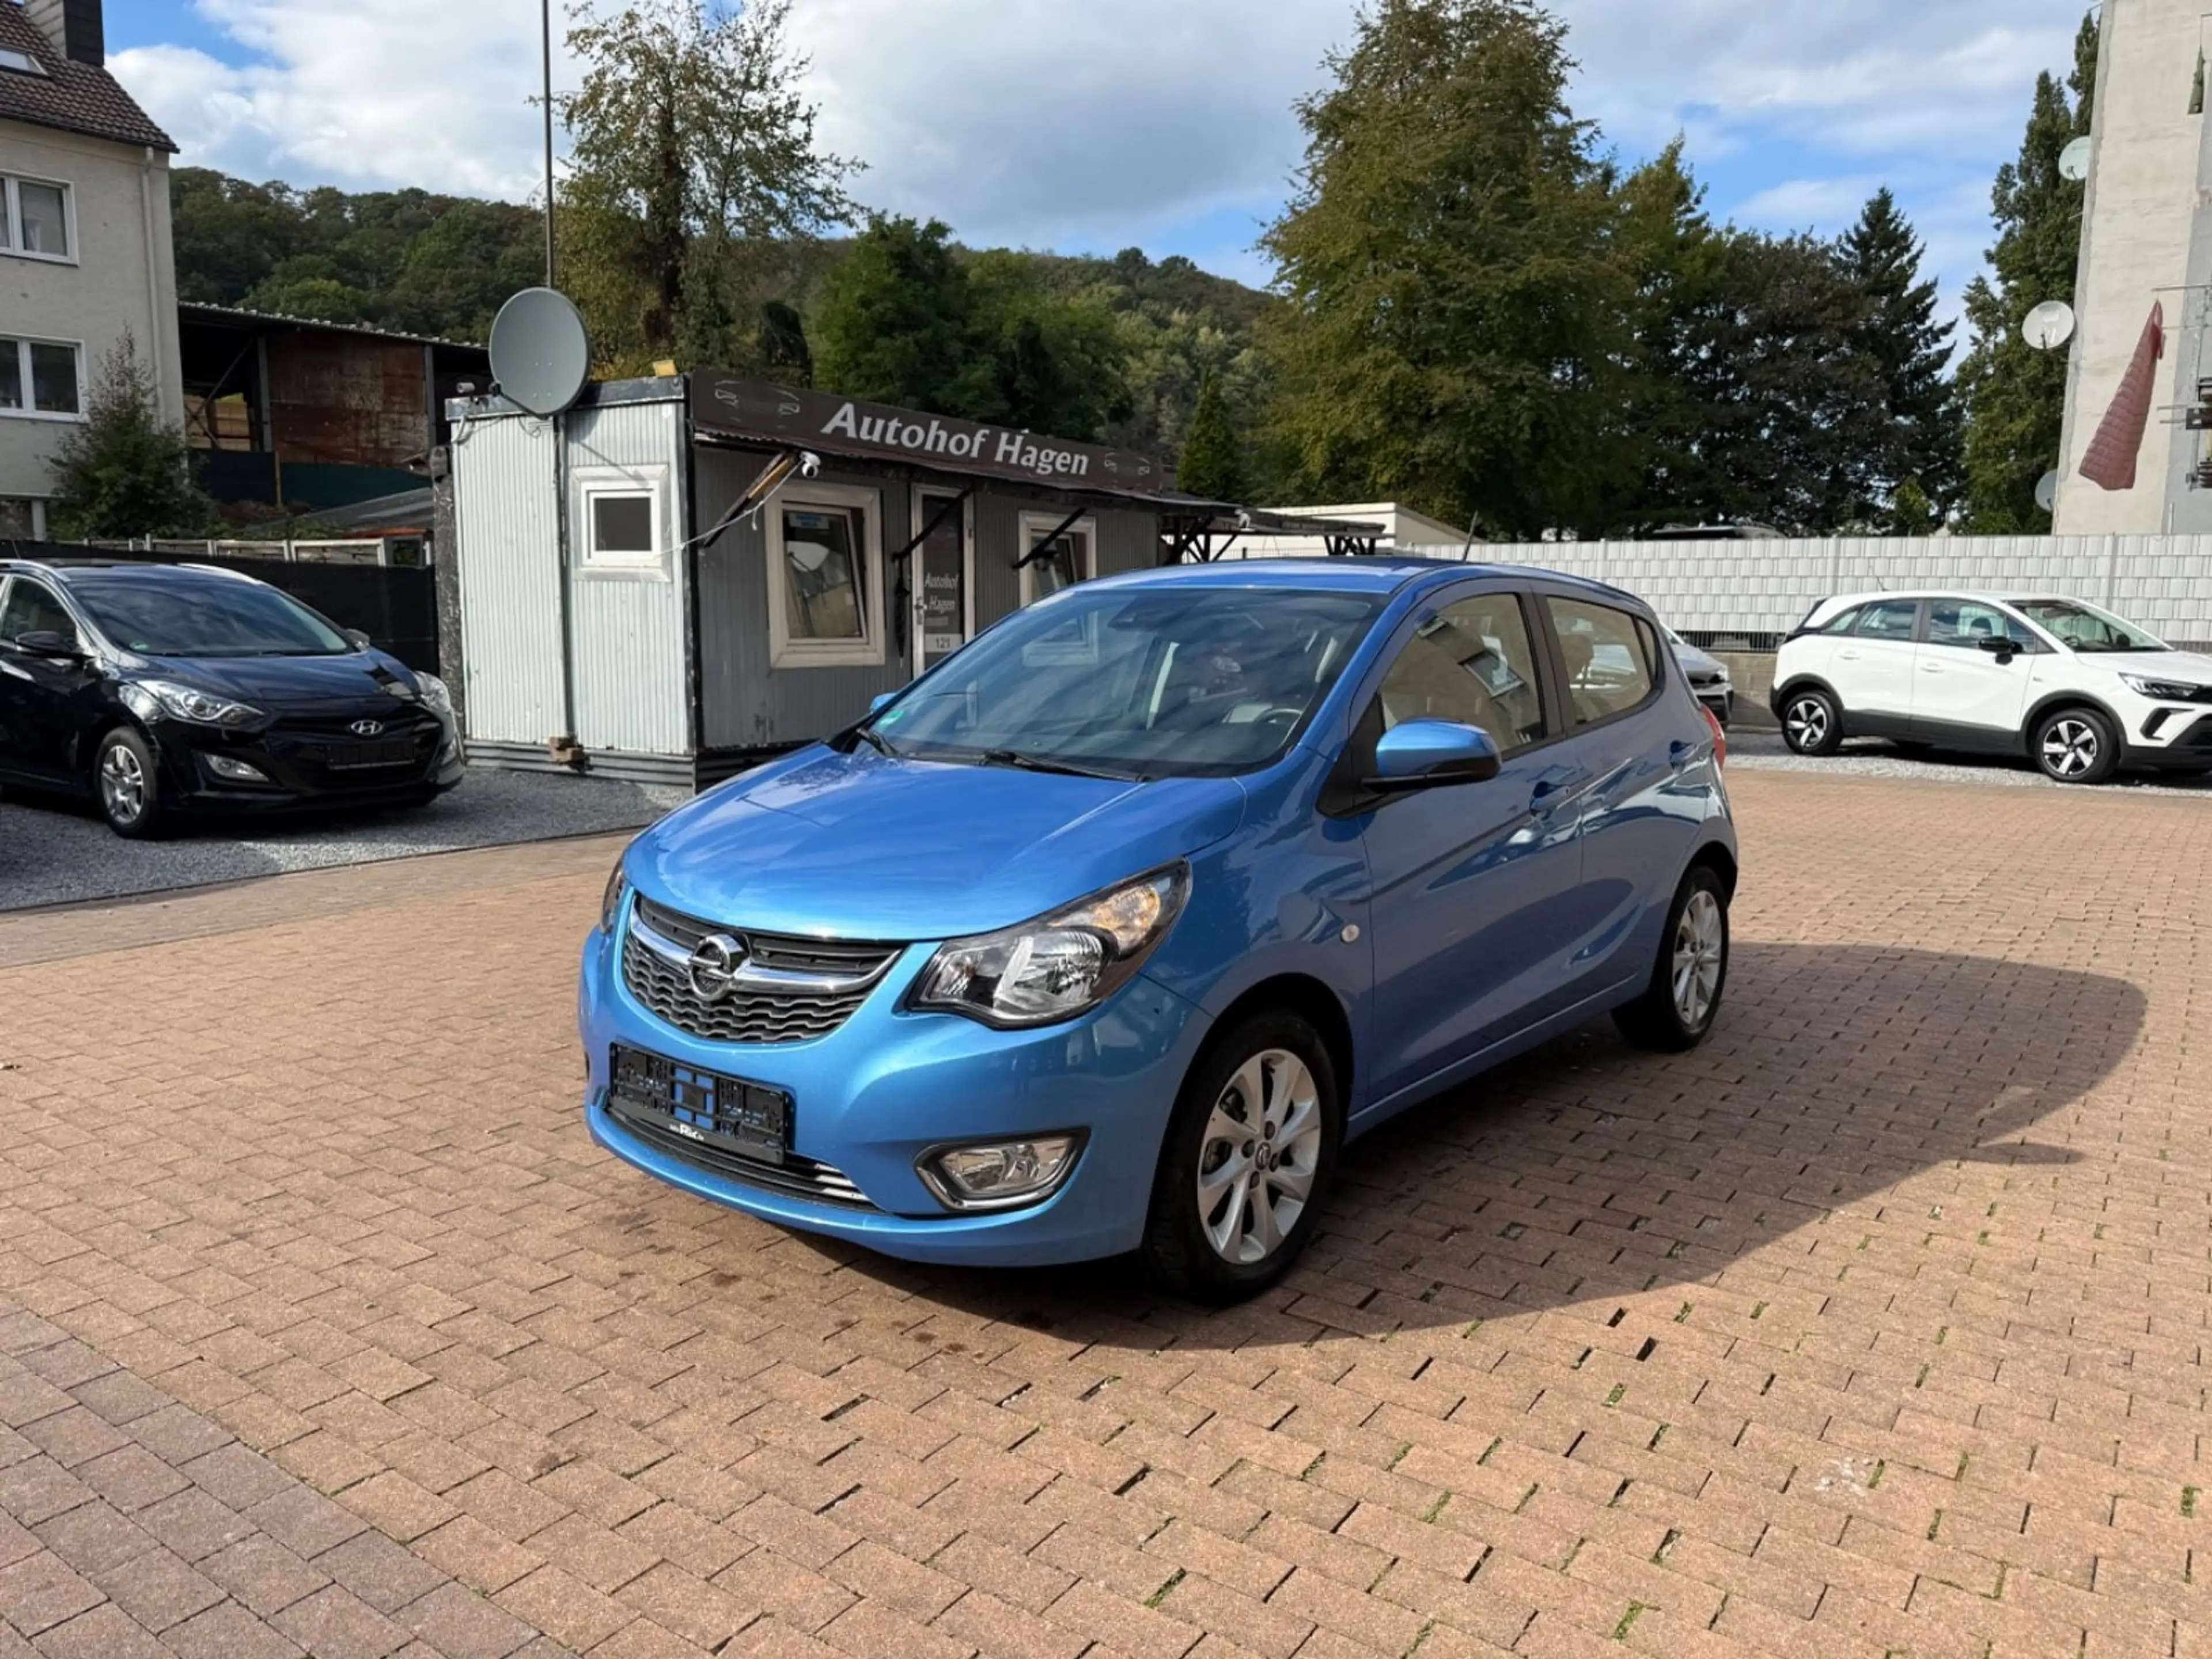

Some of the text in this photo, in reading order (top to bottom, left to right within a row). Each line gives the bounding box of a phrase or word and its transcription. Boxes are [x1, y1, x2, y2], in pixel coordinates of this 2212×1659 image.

[820, 402, 1089, 475] Autohof Hagen
[925, 573, 959, 588] Autohof
[929, 595, 955, 614] Hagen
